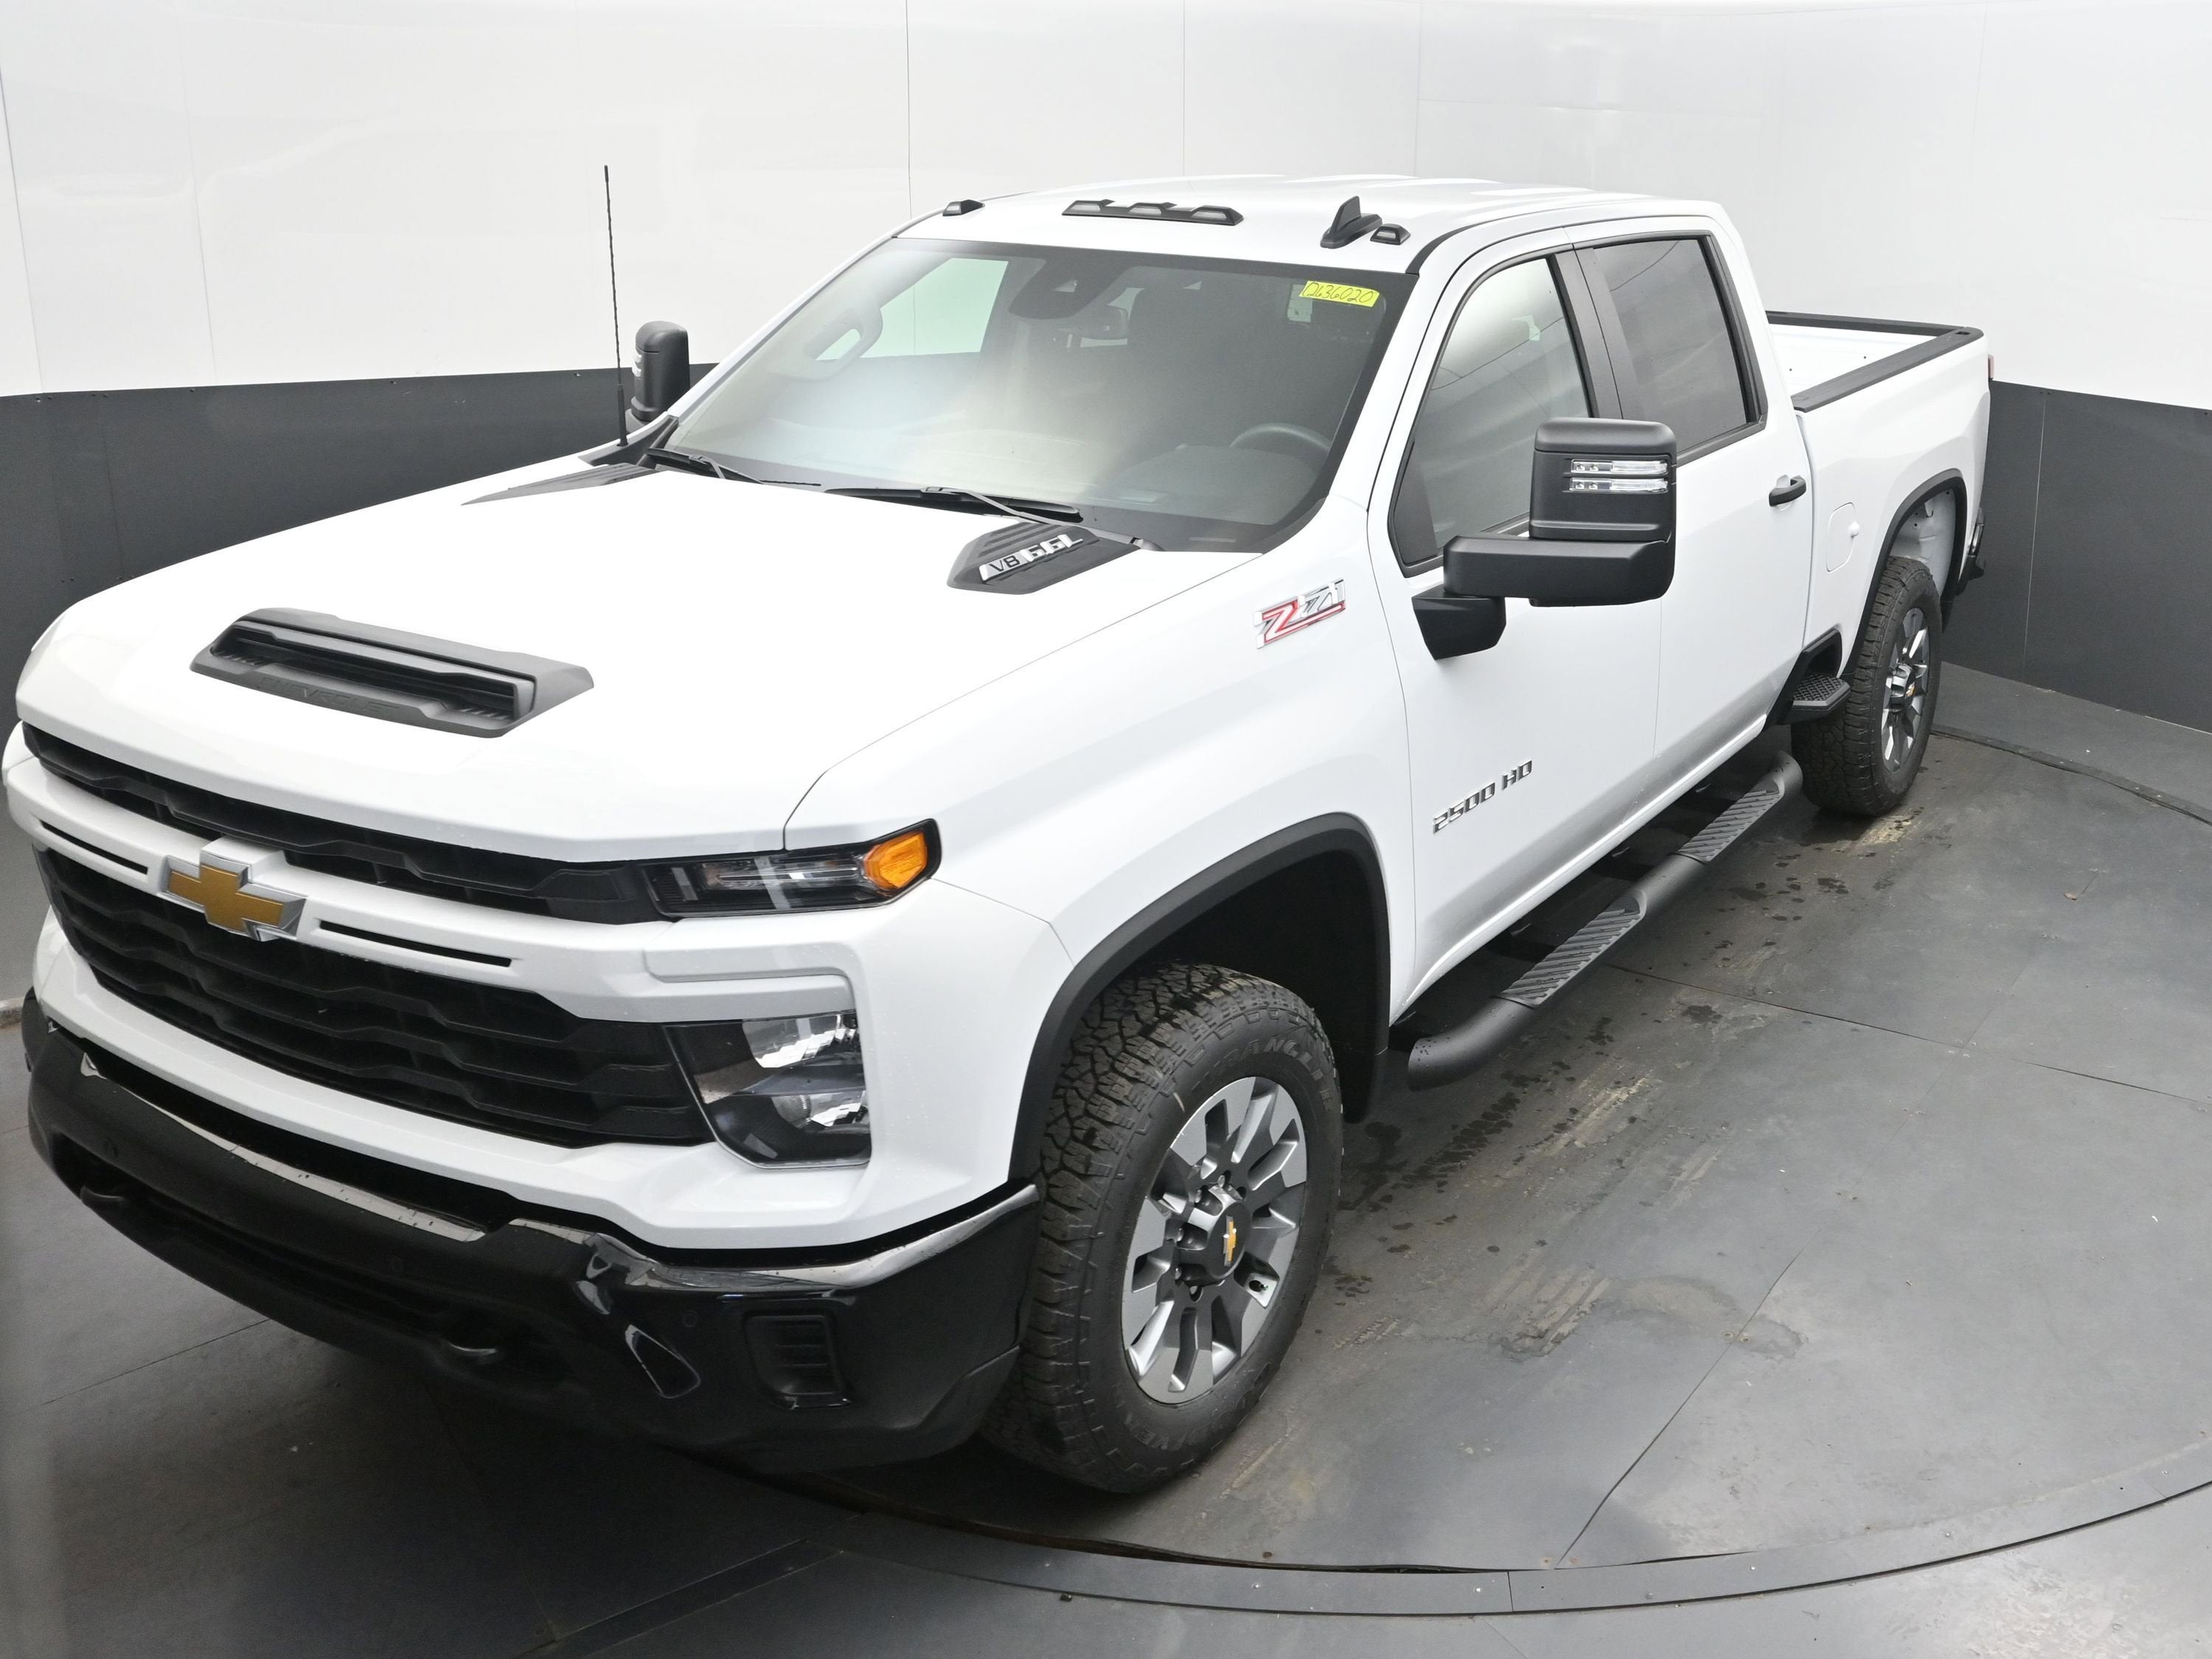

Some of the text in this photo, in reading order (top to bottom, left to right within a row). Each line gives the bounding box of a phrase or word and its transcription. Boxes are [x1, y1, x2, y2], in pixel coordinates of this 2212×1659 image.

[989, 554, 1020, 572] V8
[1253, 579, 1346, 649] Z71
[1433, 759, 1532, 834] 2500 HD
[1192, 1037, 1335, 1111] RANGLER
